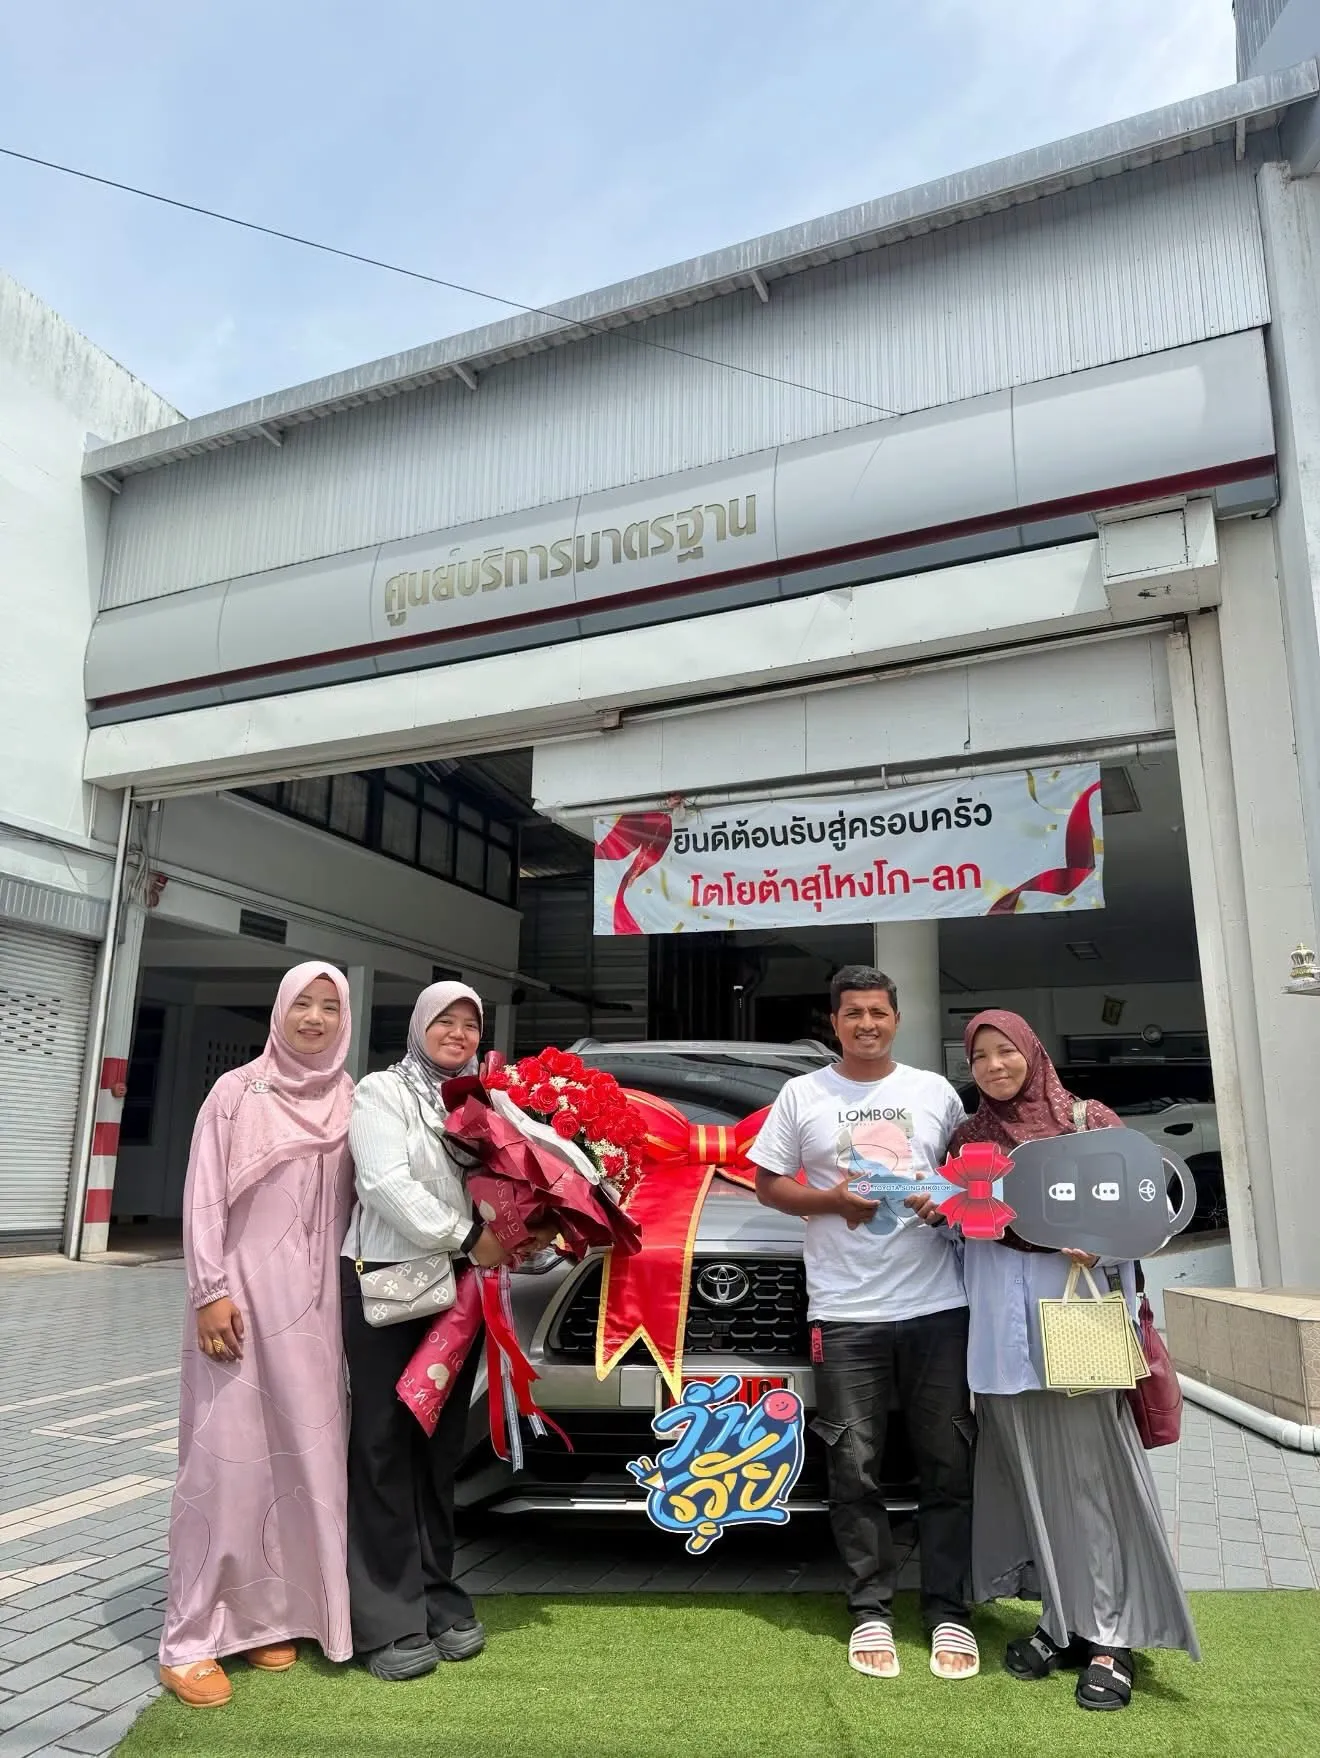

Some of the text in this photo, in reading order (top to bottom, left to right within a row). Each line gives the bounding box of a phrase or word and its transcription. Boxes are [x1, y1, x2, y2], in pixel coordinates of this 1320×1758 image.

[385, 494, 757, 627] ศูนย์บริการมาตรฐาน
[673, 797, 993, 855] ยินดีต้อนรับสู่ครอบครัว
[690, 859, 982, 913] โตโยต้าสุไหงโก-ลก
[838, 1107, 907, 1124] LOMBOK
